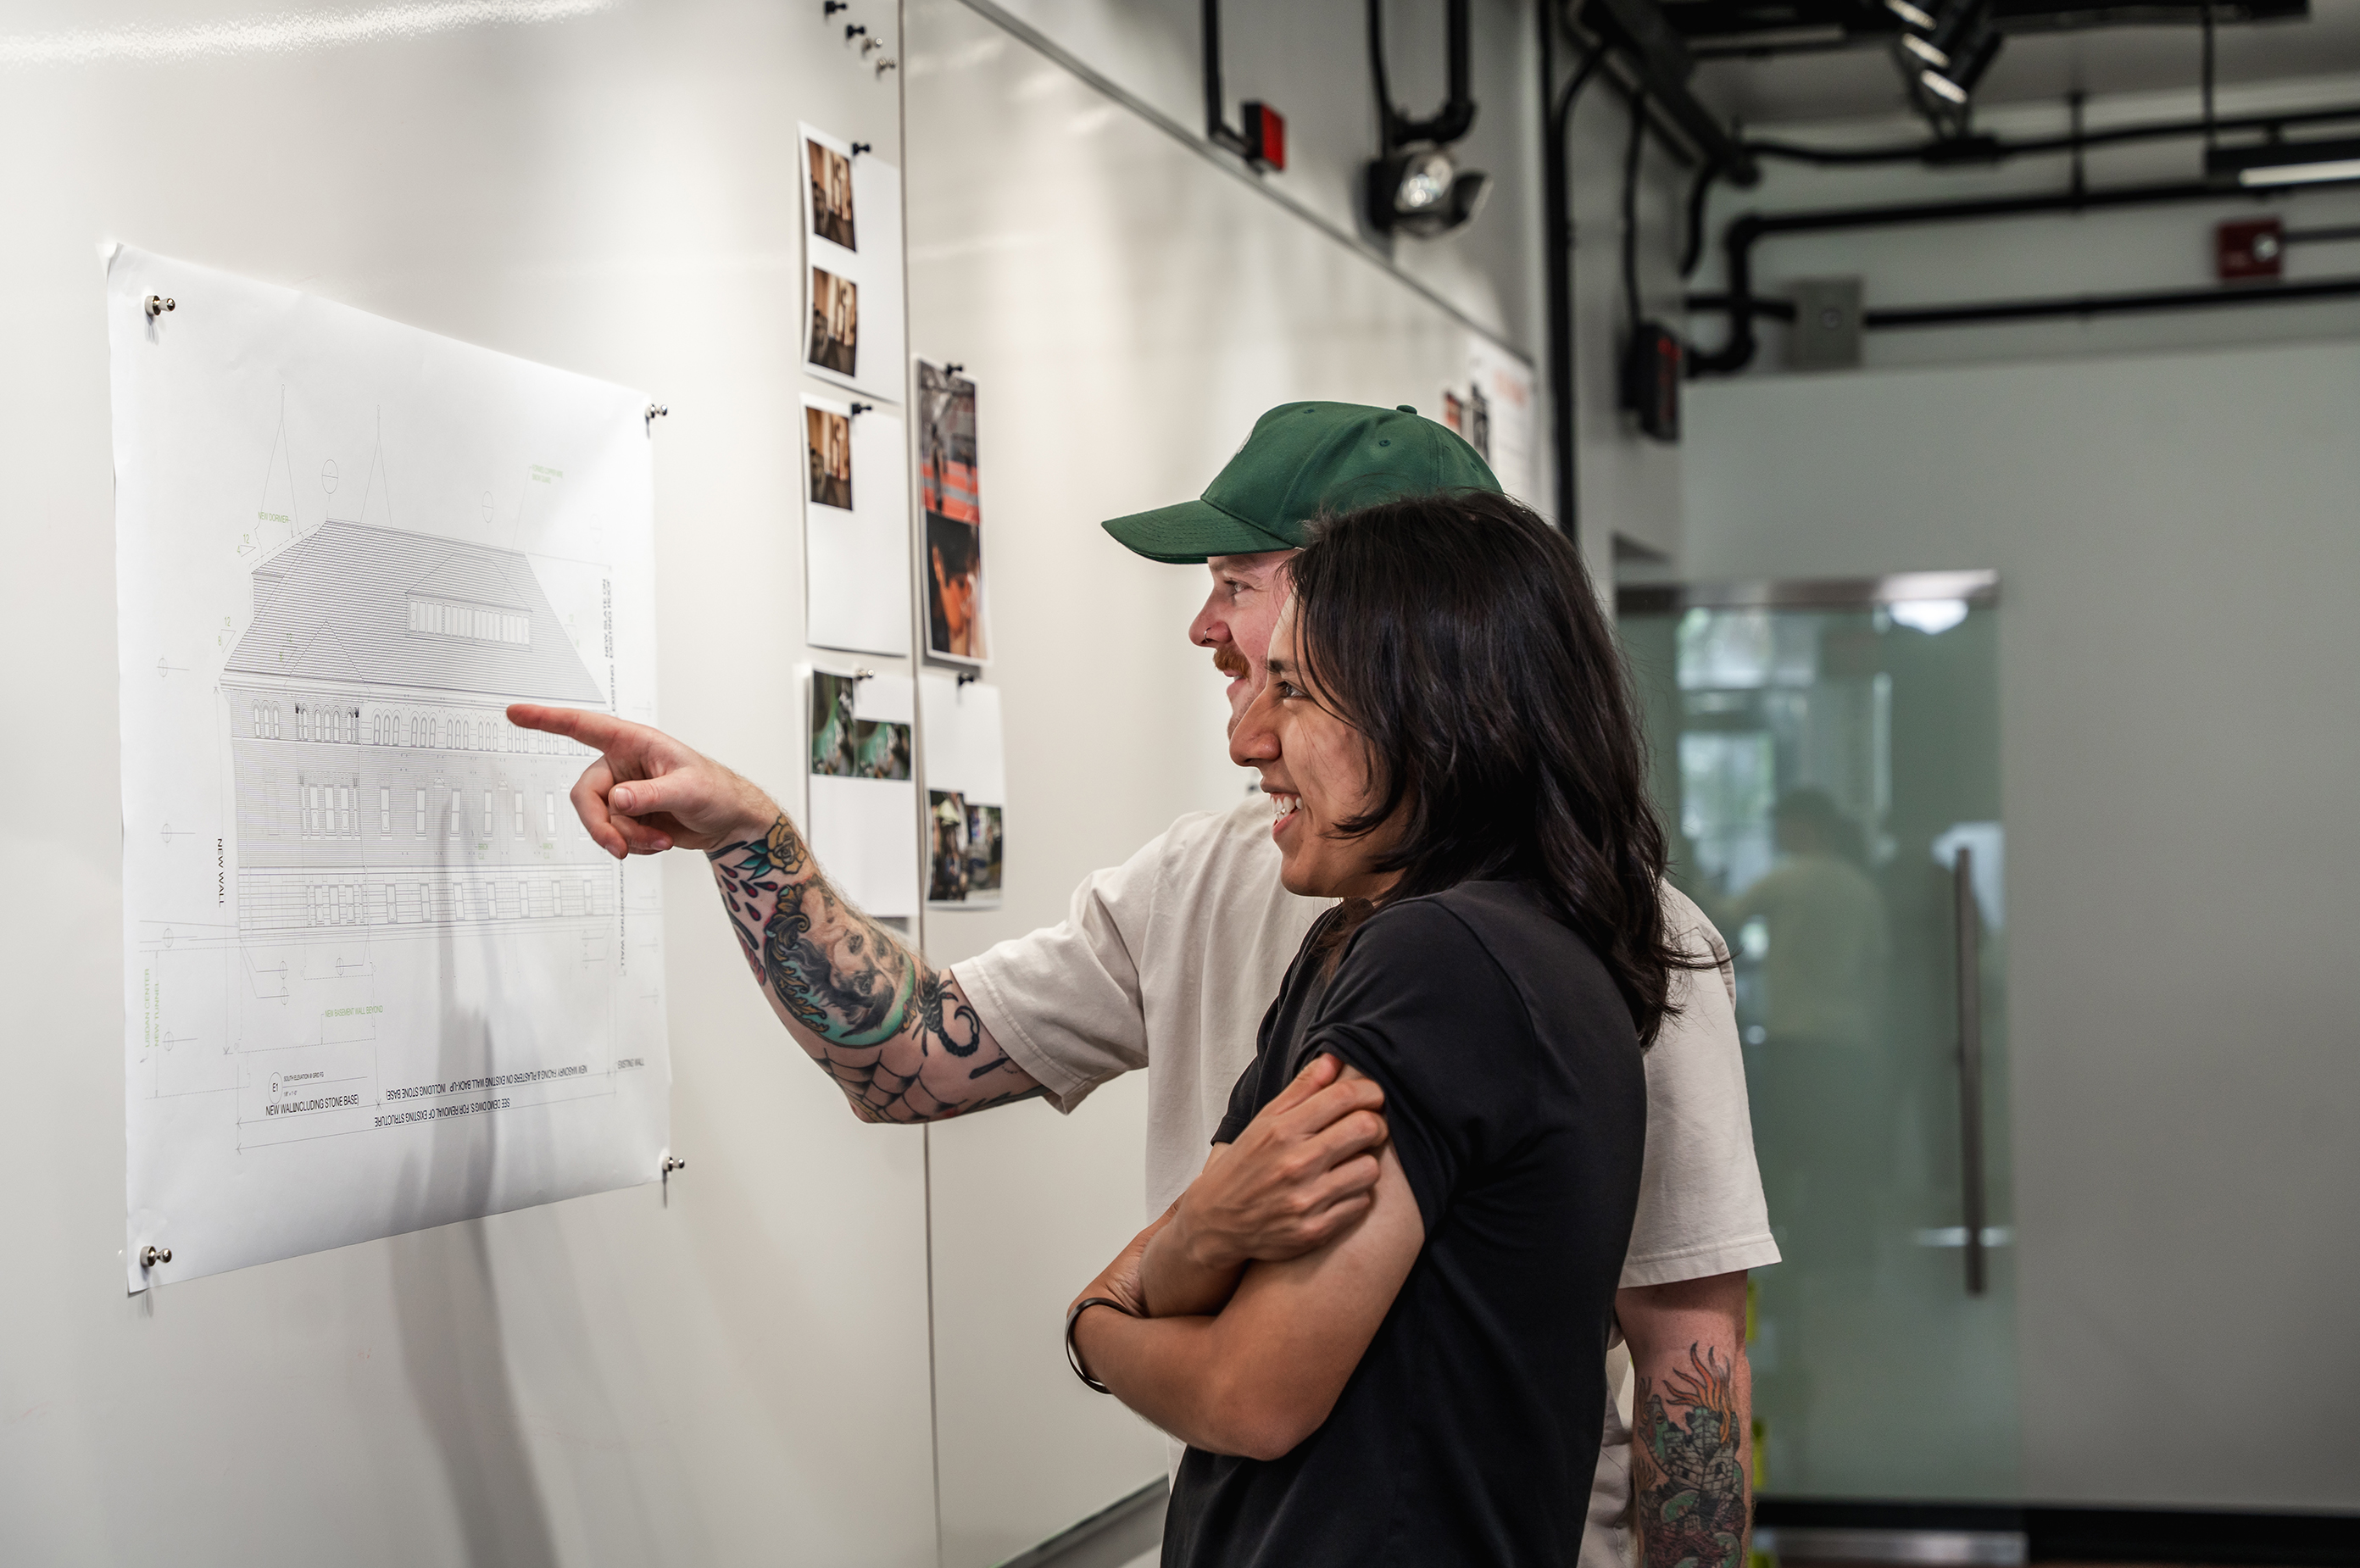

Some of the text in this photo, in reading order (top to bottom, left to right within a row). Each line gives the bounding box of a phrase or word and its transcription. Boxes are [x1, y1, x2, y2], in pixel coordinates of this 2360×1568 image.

[258, 511, 289, 524] NEW DORMER
[242, 533, 250, 544] 12
[224, 616, 231, 627] 12
[217, 635, 222, 647] 8
[325, 1004, 384, 1018] NEW BASEMENT WALL BEYOND
[541, 1069, 557, 1080] FACING
[558, 1066, 578, 1078] MASONRY
[471, 1078, 484, 1089] WALL
[485, 1075, 505, 1087] EXISTING
[506, 1074, 514, 1084] ON
[272, 1082, 279, 1093] E1
[449, 1080, 471, 1093] BACK-UP
[386, 1088, 401, 1100] BASE)
[402, 1087, 419, 1098] STONE
[265, 1104, 280, 1116] NEW
[325, 1095, 343, 1108] STONE
[343, 1093, 359, 1106] BASE)
[487, 1099, 501, 1110] DEMO
[501, 1098, 511, 1108] SEE
[427, 1109, 436, 1119] OF
[437, 1105, 459, 1118] REMOVAL
[459, 1104, 470, 1114] FOR
[375, 1114, 404, 1127] STRUCTURE
[405, 1109, 427, 1122] EXISTING
